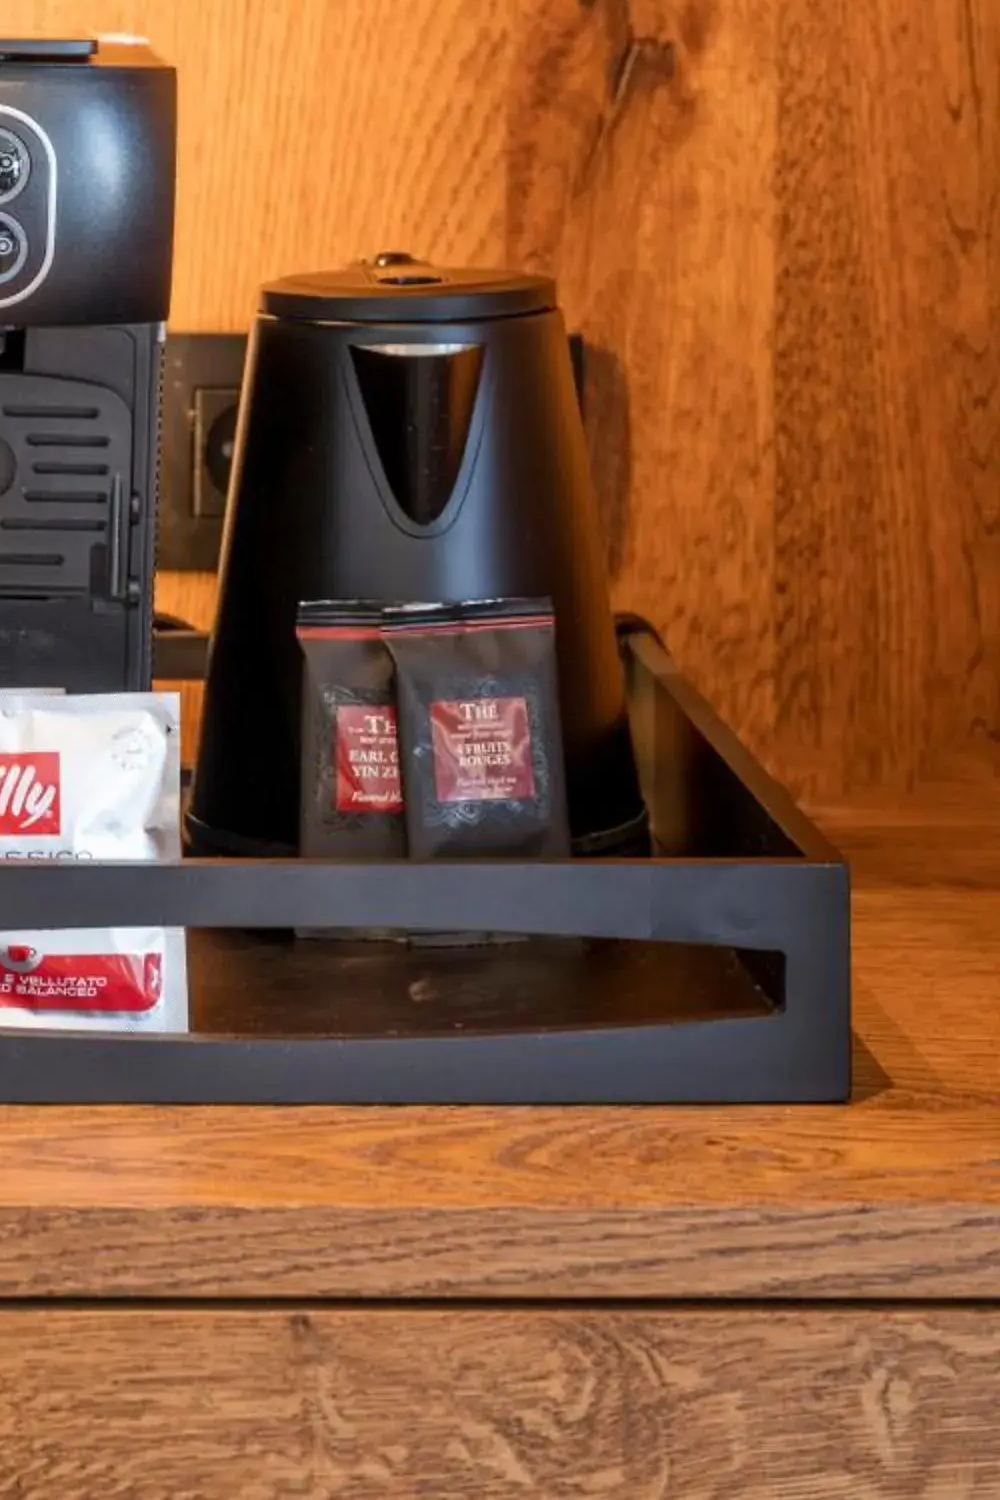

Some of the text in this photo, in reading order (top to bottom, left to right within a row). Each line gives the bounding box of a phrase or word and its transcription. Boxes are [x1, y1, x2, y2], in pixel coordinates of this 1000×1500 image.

[348, 749, 387, 763] EARL
[4, 973, 14, 984] E
[19, 975, 108, 987] VELLUTATO
[16, 985, 98, 998] BALANCED
